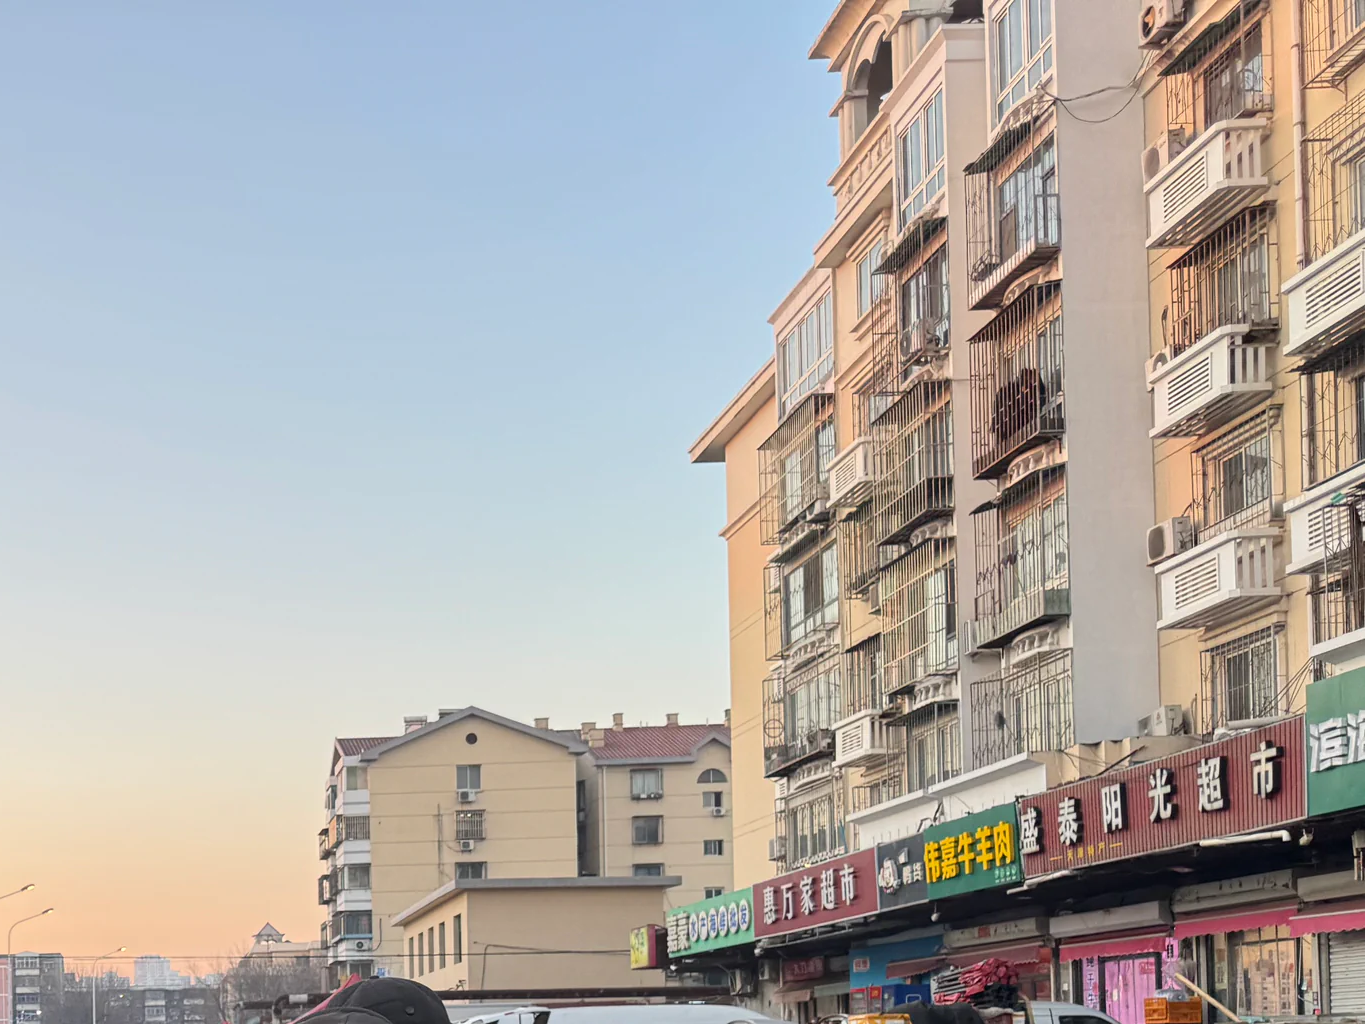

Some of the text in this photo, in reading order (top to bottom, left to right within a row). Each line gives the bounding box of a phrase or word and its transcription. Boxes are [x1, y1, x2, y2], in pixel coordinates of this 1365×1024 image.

[1020, 740, 1279, 854] 盛泰阳光超市
[923, 821, 1014, 883] 伟嘉牛羊肉
[762, 864, 856, 925] 惠万家超市
